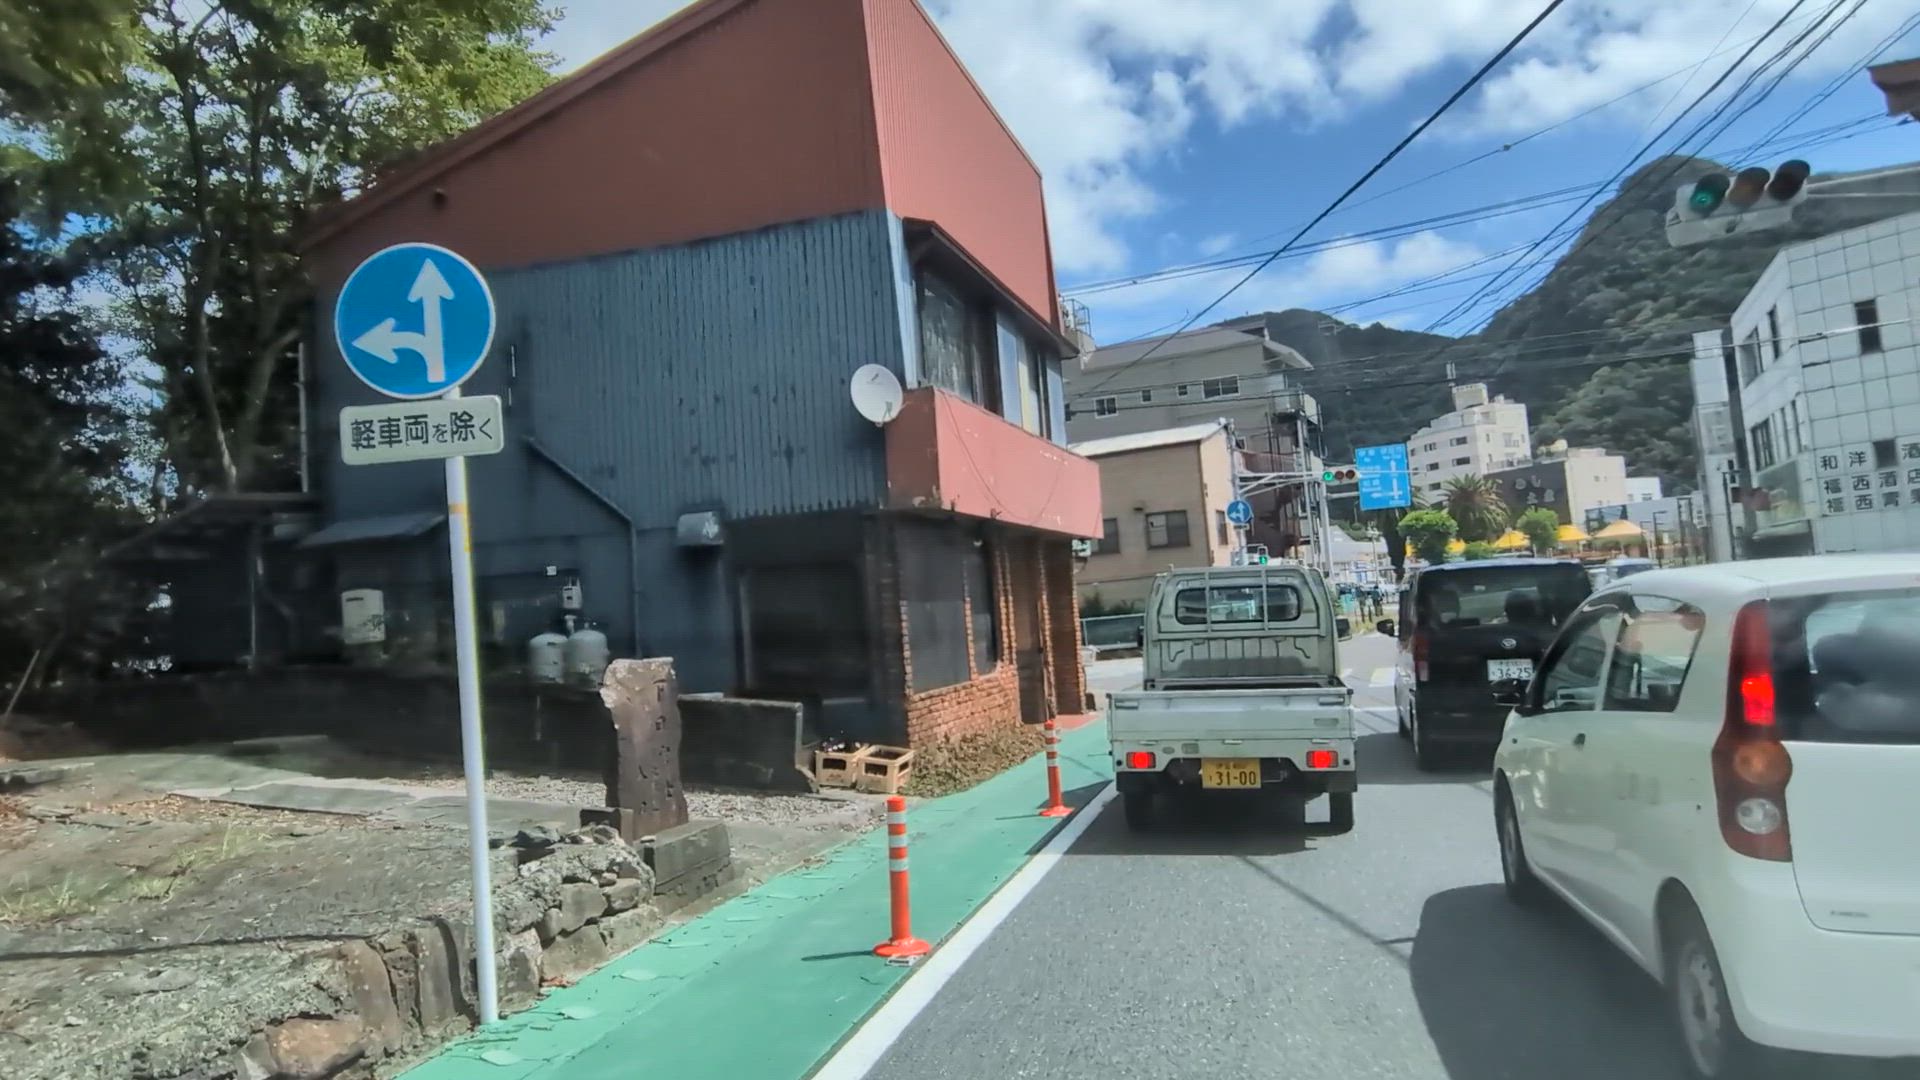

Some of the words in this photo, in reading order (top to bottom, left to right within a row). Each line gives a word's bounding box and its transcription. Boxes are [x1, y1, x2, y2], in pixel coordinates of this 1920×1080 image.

[350, 410, 493, 450] 軽車両を除く
[1215, 770, 1257, 786] 31-00
